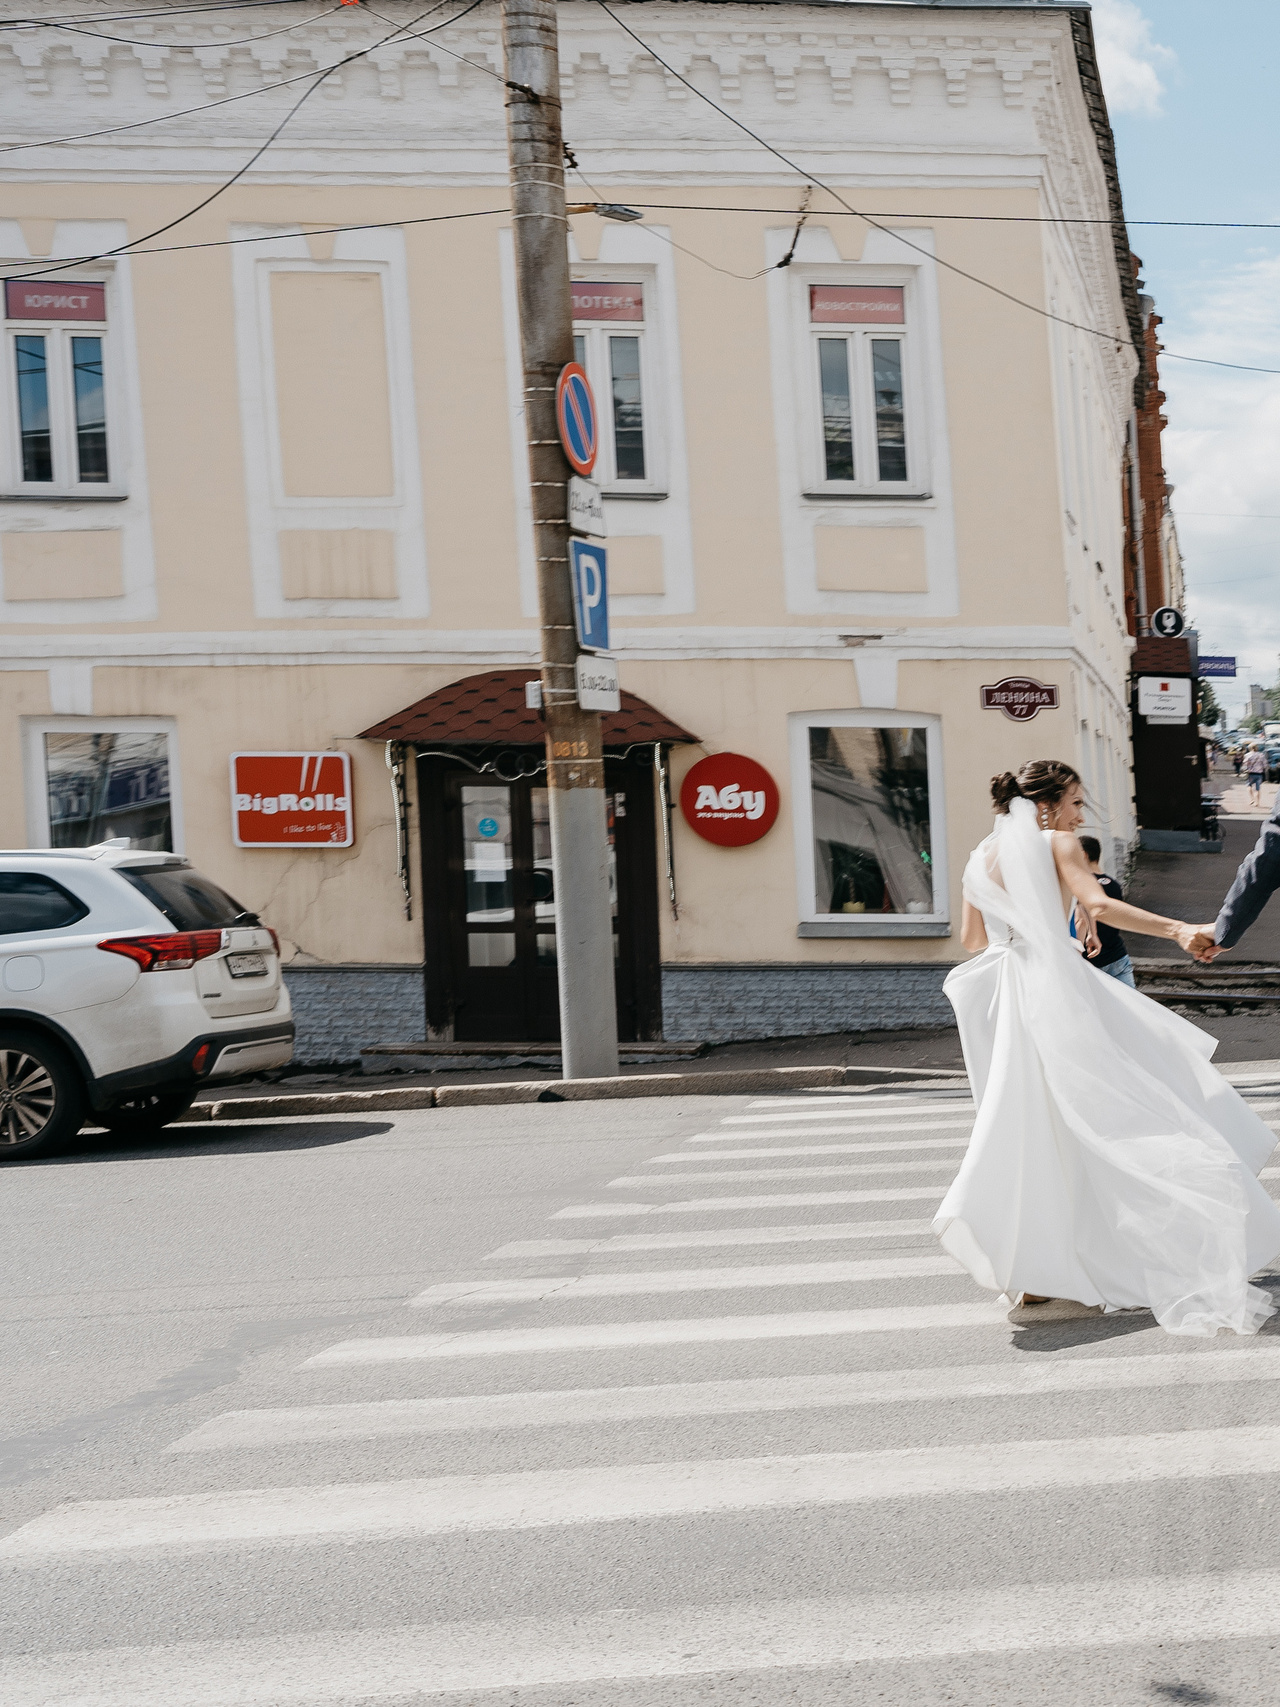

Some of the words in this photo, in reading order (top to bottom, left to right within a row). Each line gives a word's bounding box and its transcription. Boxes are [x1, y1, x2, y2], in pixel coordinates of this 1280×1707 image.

[24, 294, 90, 309] ЮРИСТ
[570, 295, 636, 309] ПОТЕКА
[990, 691, 1051, 704] ЛЕНИНА
[1012, 704, 1029, 716] 77
[235, 793, 349, 815] BigRolls
[694, 783, 766, 820] Абу
